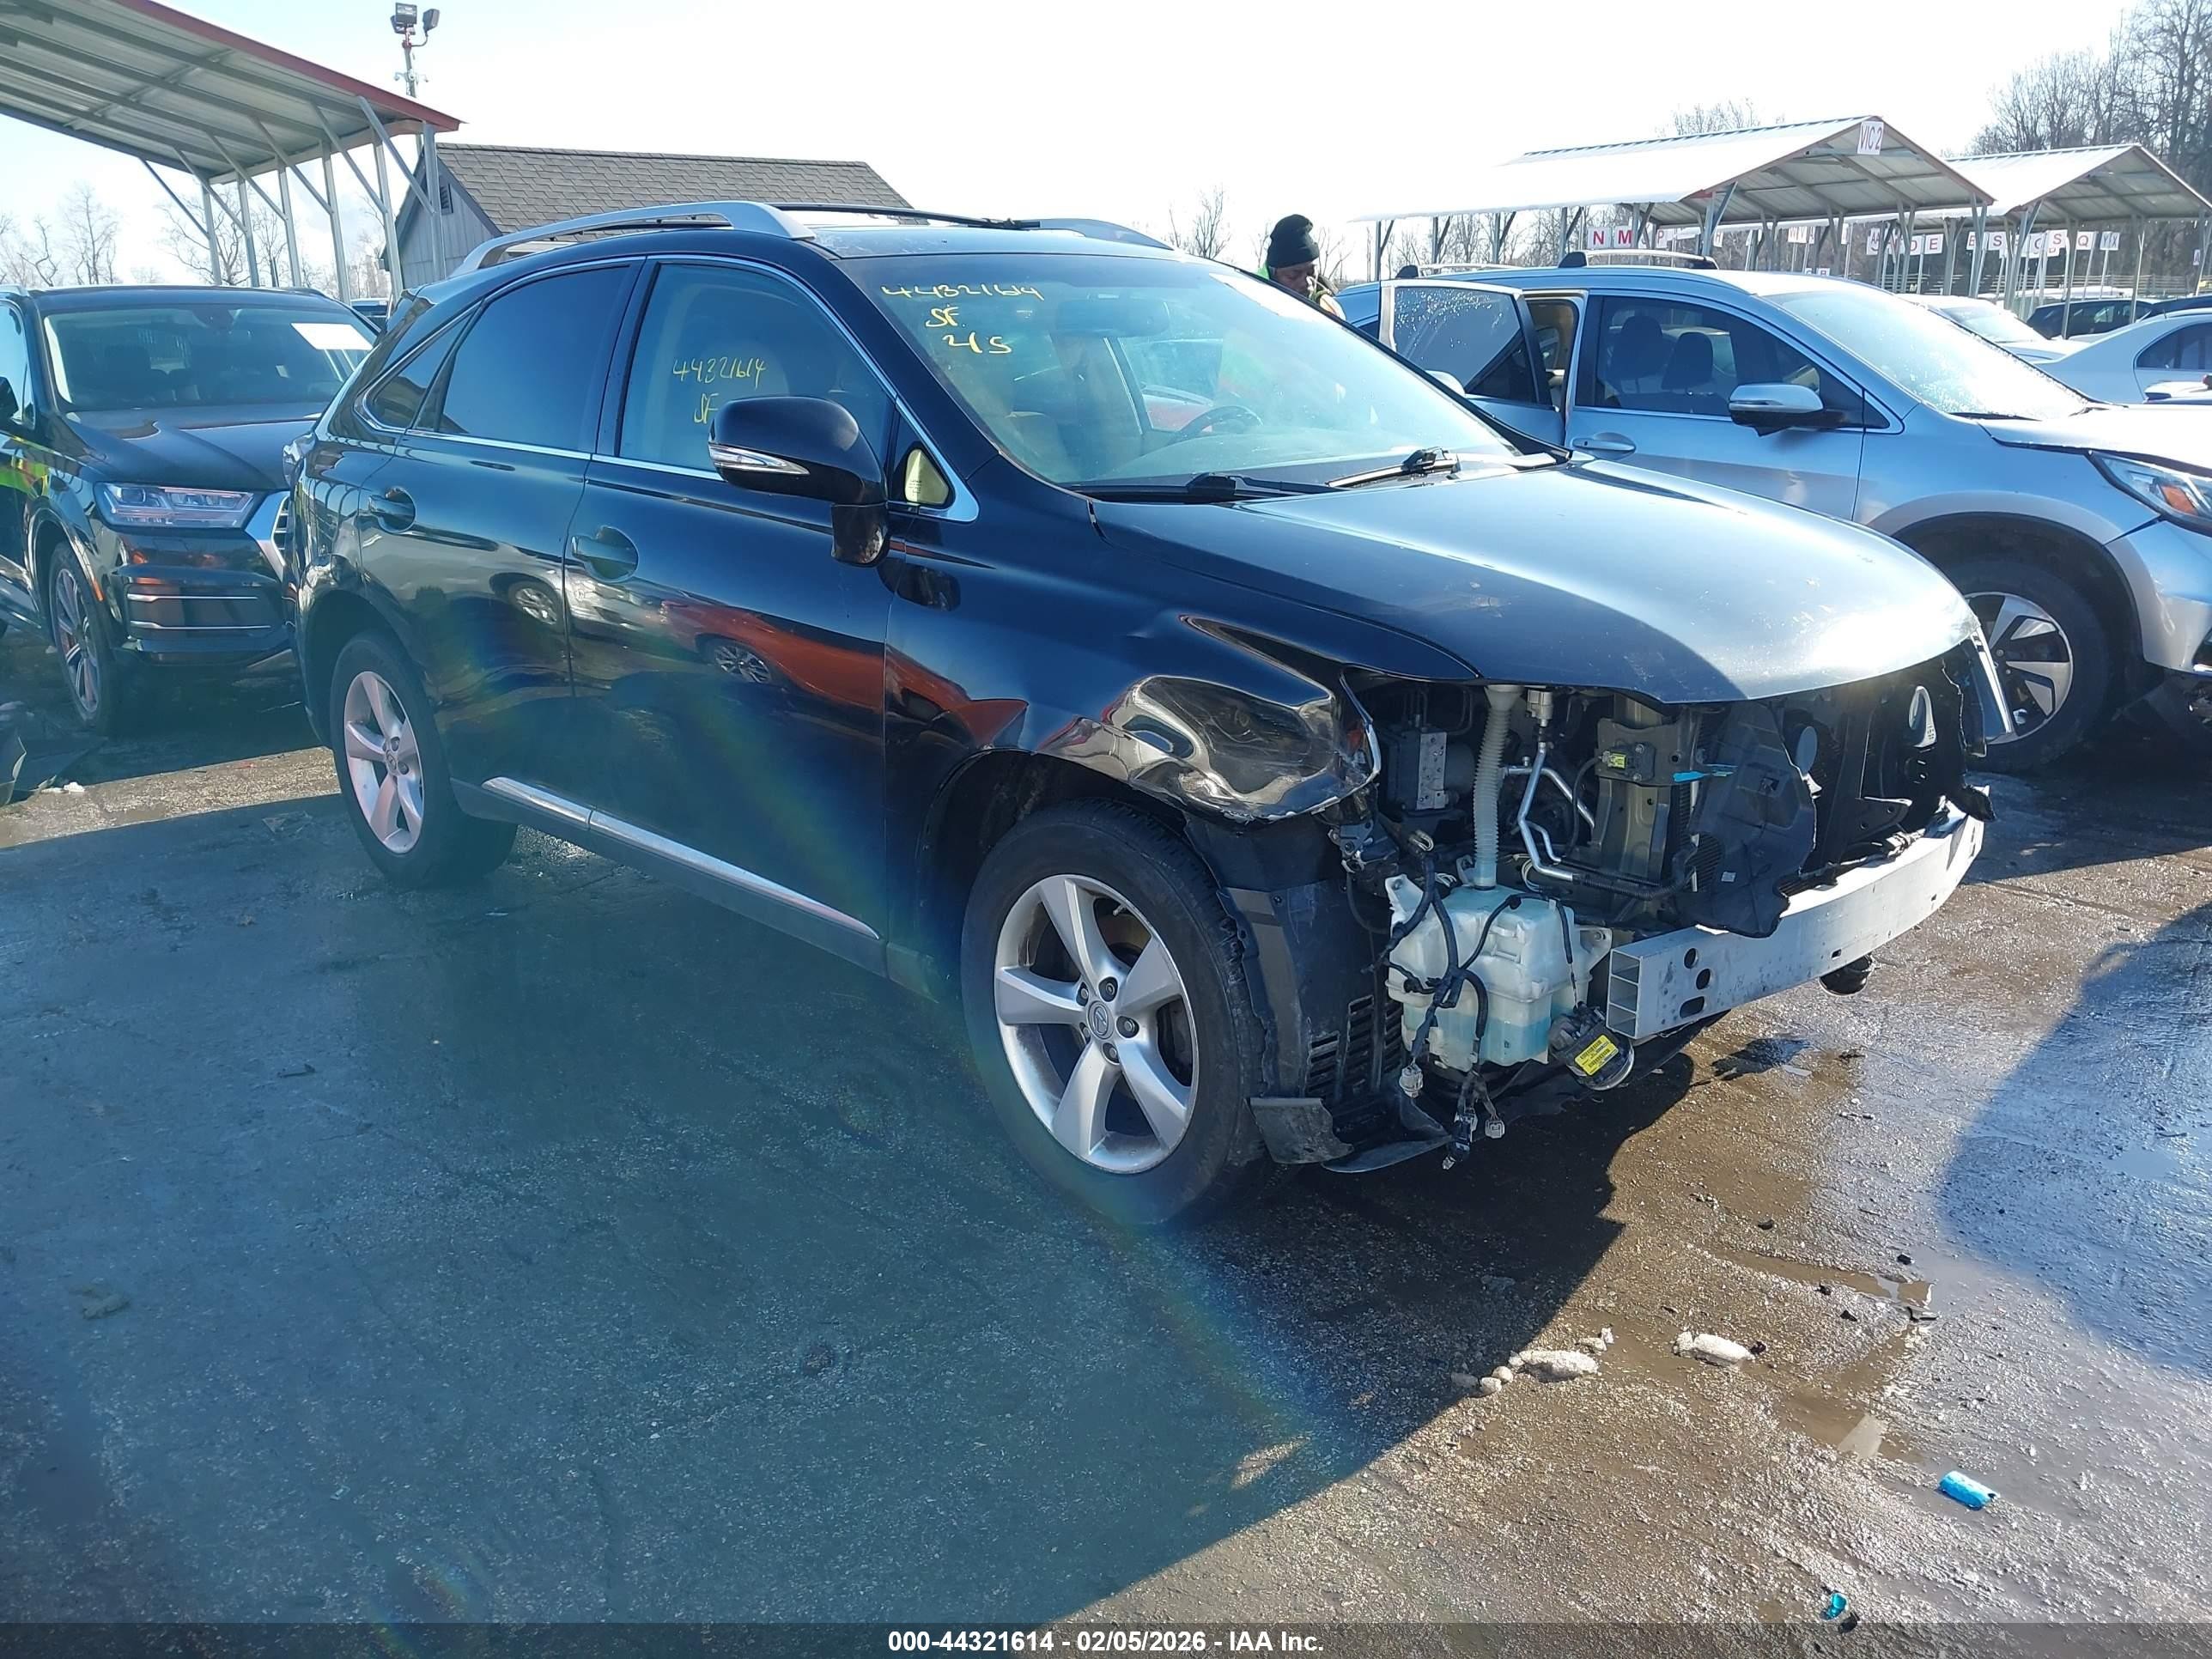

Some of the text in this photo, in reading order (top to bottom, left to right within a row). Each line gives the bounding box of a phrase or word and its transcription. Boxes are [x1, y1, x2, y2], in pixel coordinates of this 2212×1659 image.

[1593, 230, 1604, 246] N
[1618, 229, 1633, 245] M
[1993, 234, 2002, 246] S
[2053, 233, 2062, 245] S
[2078, 234, 2089, 247] Q
[1929, 238, 1938, 250] E
[672, 356, 767, 390] 44321614
